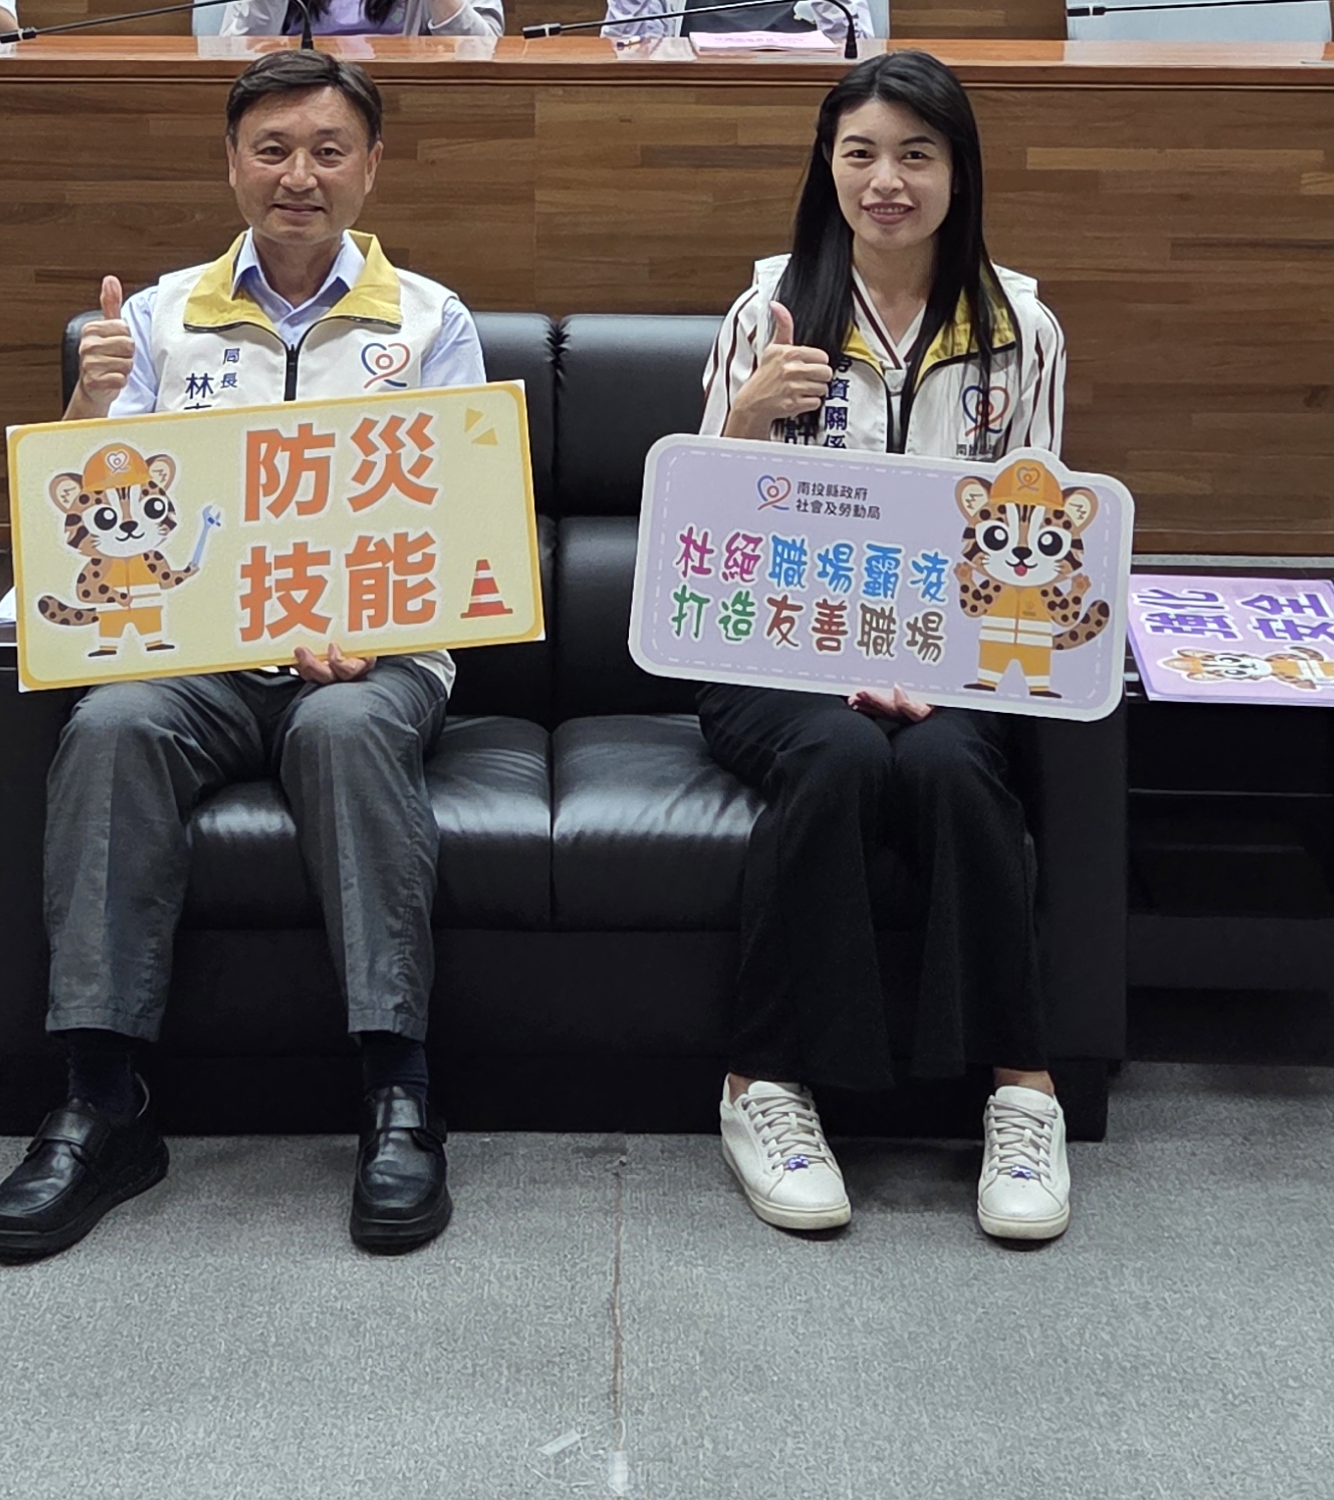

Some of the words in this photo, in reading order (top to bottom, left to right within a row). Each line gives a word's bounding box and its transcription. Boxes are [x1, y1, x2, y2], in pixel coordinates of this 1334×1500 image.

[220, 348, 241, 389] 局長
[243, 412, 439, 522] 防災
[797, 481, 869, 501] 南投縣政府
[796, 498, 881, 520] 社會及勞動局
[239, 532, 437, 642] 技能
[670, 584, 944, 662] 打造友善職場
